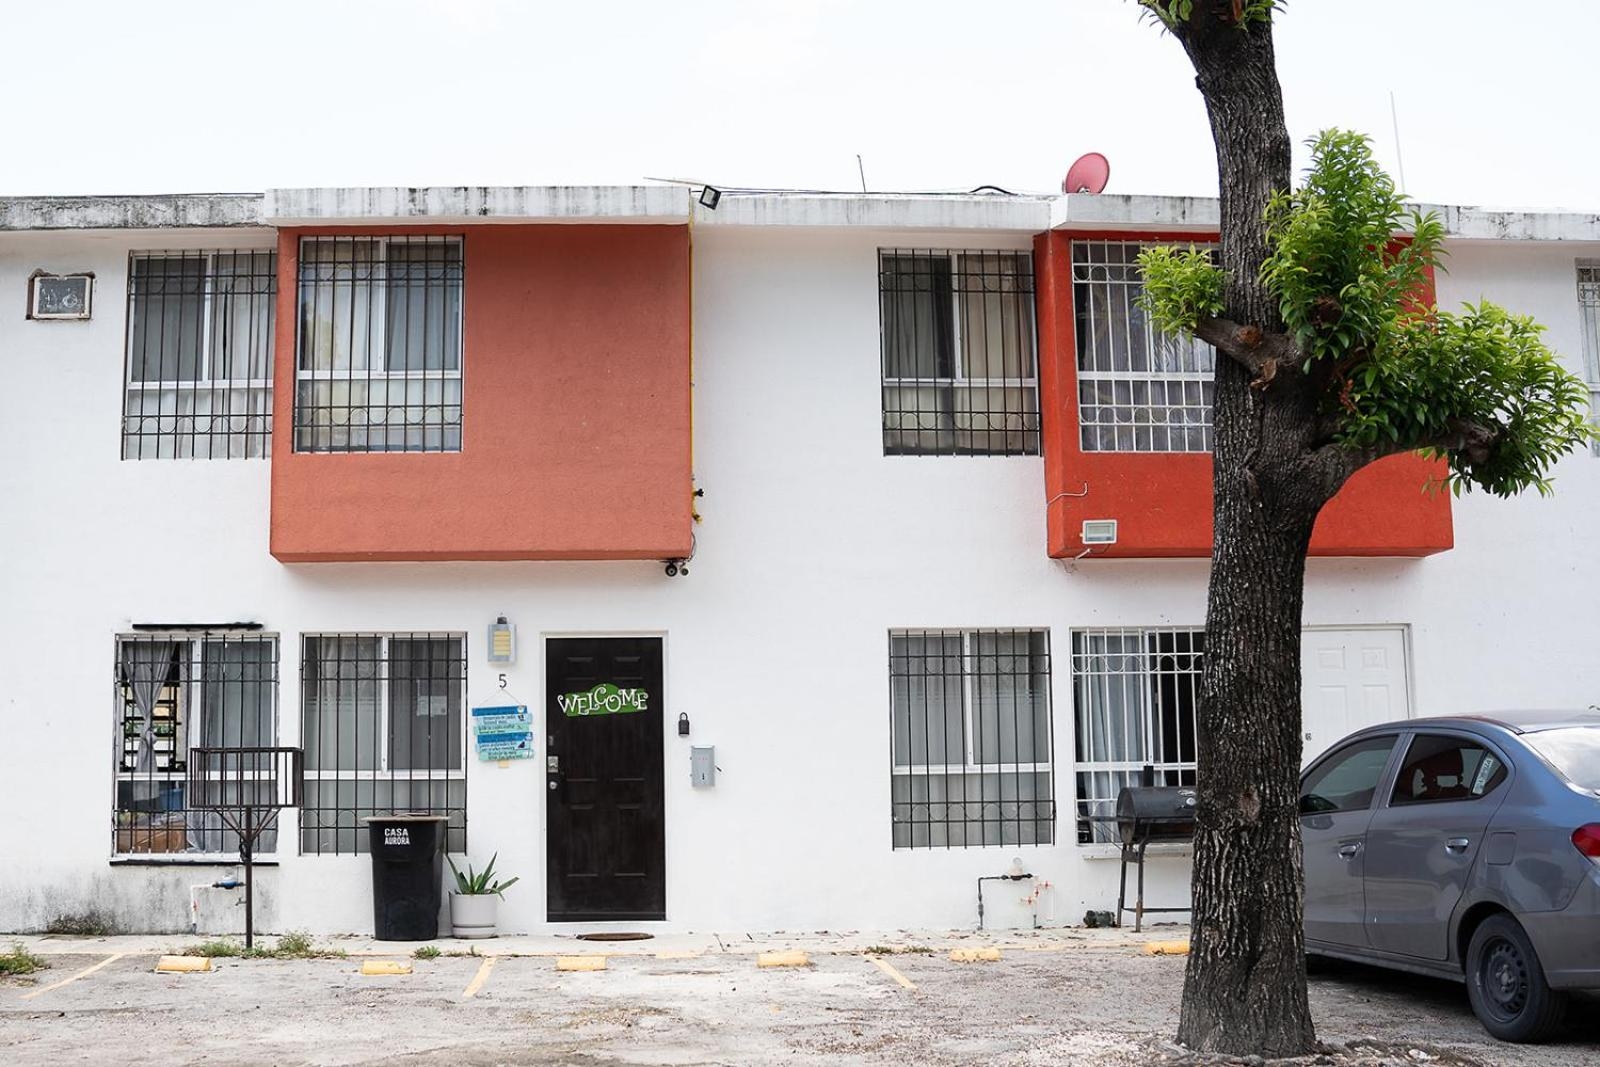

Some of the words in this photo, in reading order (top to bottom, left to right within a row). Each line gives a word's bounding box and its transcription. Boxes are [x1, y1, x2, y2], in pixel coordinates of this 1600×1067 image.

[498, 673, 507, 689] 5
[557, 686, 648, 715] WELCOME
[384, 828, 409, 837] CASA
[384, 837, 410, 846] AURORA
